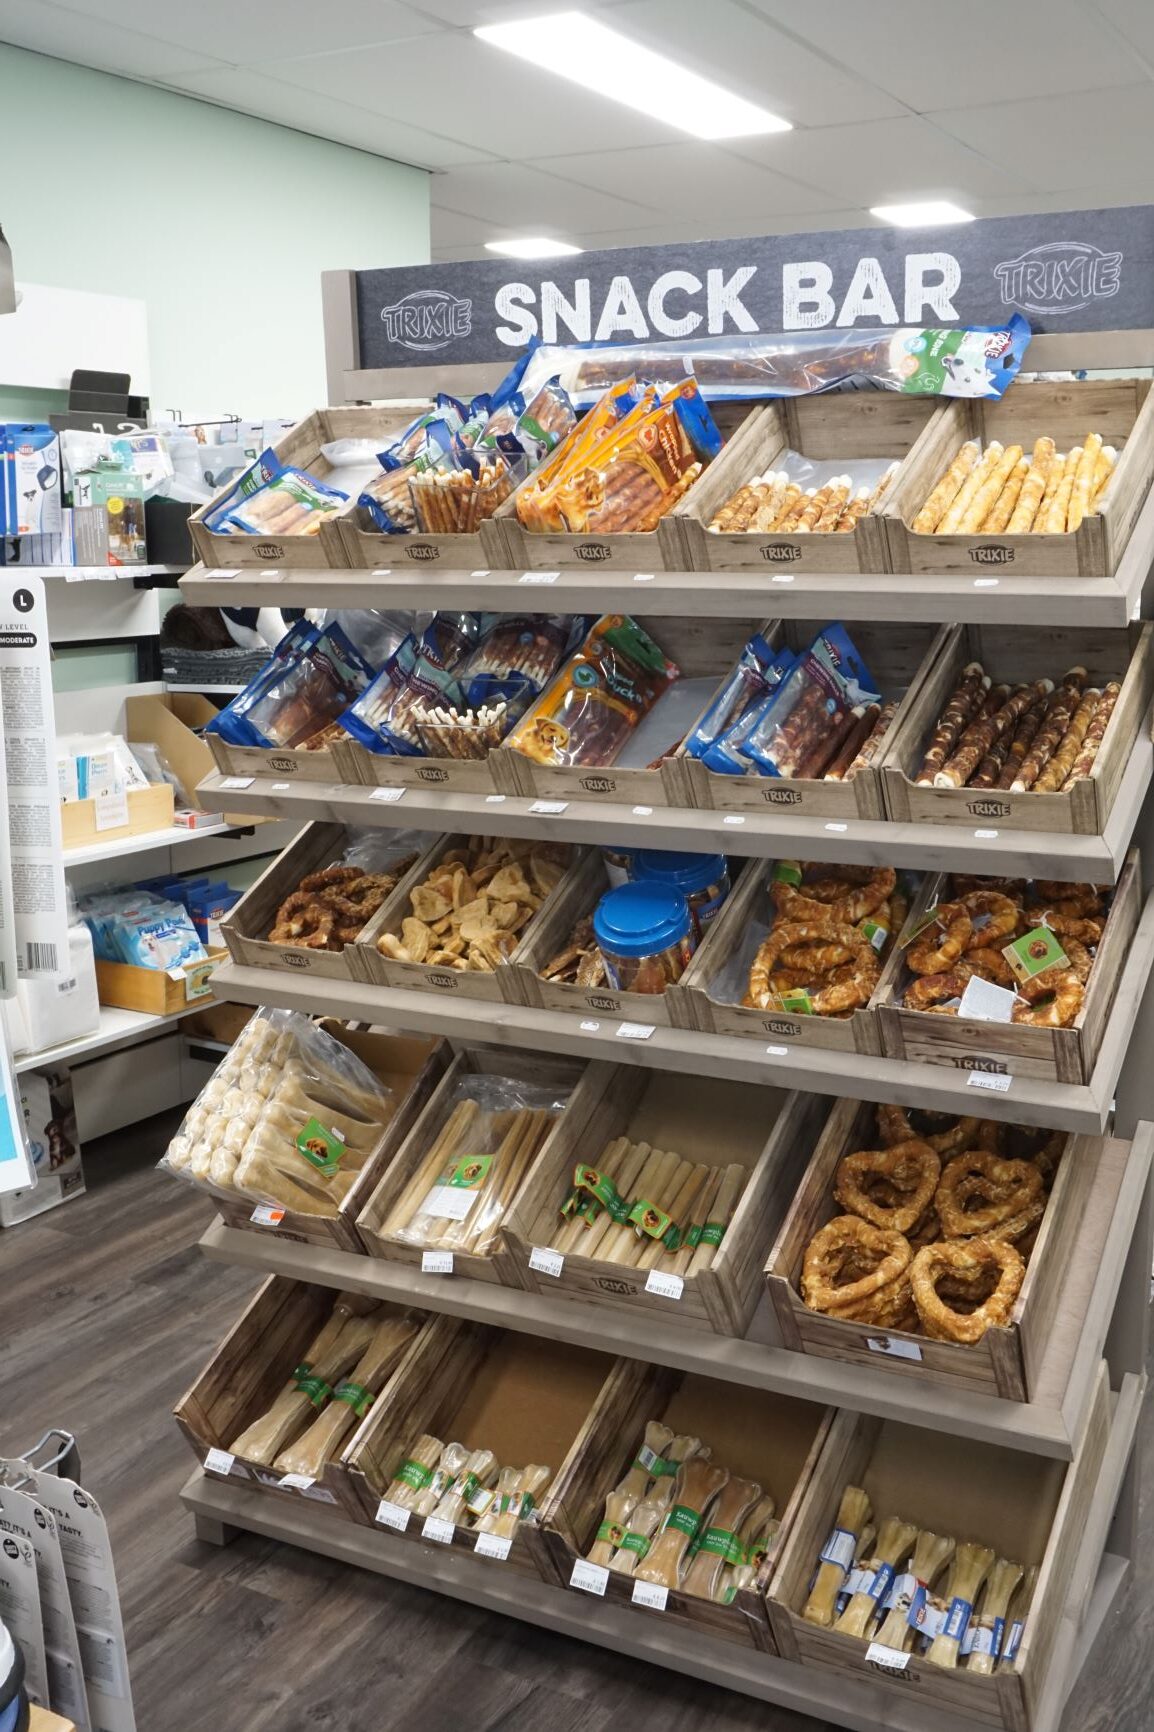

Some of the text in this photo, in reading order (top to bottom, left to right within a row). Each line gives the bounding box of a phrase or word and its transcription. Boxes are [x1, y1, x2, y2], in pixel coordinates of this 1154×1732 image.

[994, 251, 1123, 304] TRIXIE
[494, 252, 961, 347] SNACK BAR
[381, 297, 473, 341] TRIXIE
[252, 544, 285, 559] TRIXIE
[405, 545, 440, 560] TRIXIE
[574, 545, 612, 560] TRIXIE
[760, 545, 802, 560] TRIXIE
[968, 547, 1015, 563] TRIXIE
[19, 594, 27, 607] L
[5, 623, 29, 631] LEVEL
[267, 757, 299, 773] TRIXIE
[415, 767, 450, 783] TRIXIE
[580, 776, 616, 793] TRIXIE
[762, 788, 803, 805] TRIXIE
[966, 800, 1011, 817] TRIXIE
[137, 922, 165, 937] Puppy
[280, 952, 312, 968] TRIXIE
[425, 973, 458, 989] TRIXIE
[585, 995, 621, 1011] TRIXIE
[762, 1020, 802, 1036] TRIXIE
[953, 1058, 1009, 1075] TRIXIE
[592, 1276, 639, 1297] TRIXIE
